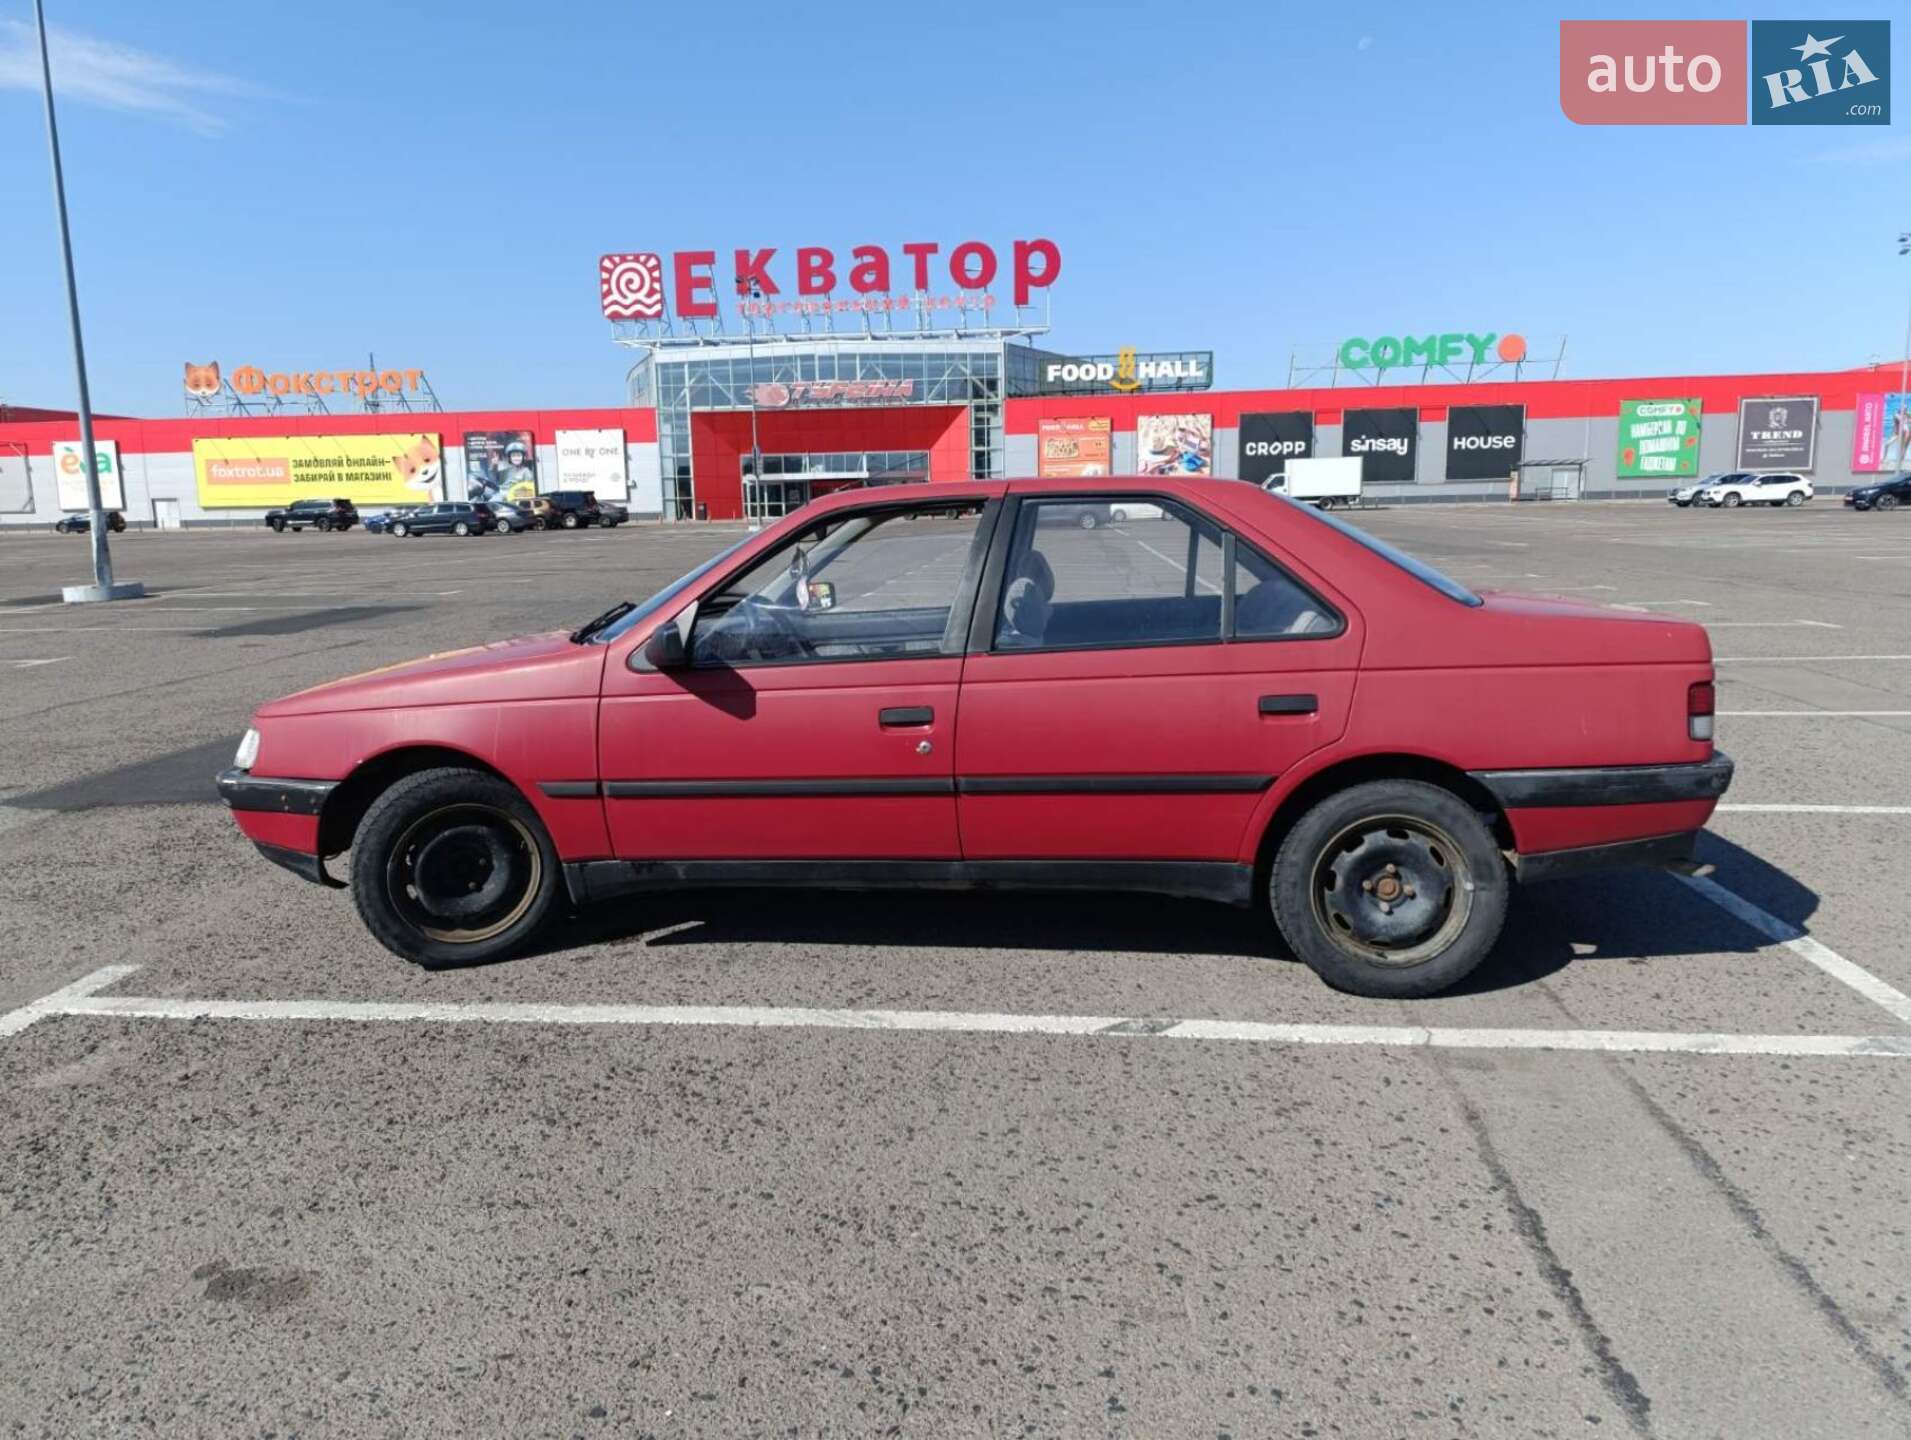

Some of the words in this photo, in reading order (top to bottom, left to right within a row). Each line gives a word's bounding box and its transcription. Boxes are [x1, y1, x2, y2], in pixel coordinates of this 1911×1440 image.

[673, 238, 1062, 317] Екватор
[1339, 332, 1497, 369] COMFY
[1047, 362, 1114, 382] FOOD
[1139, 360, 1204, 379] HALL
[230, 364, 424, 400] Фокстрот
[1750, 430, 1803, 440] TREND
[562, 447, 582, 457] ONE
[599, 446, 619, 456] ONE
[1245, 440, 1306, 456] CROPP
[1351, 435, 1409, 456] sinsay
[211, 462, 285, 479] foxtrot.ua
[292, 455, 344, 469] ЗАМОВЛЯЙ
[293, 469, 336, 483] ЗАБИРАЙ
